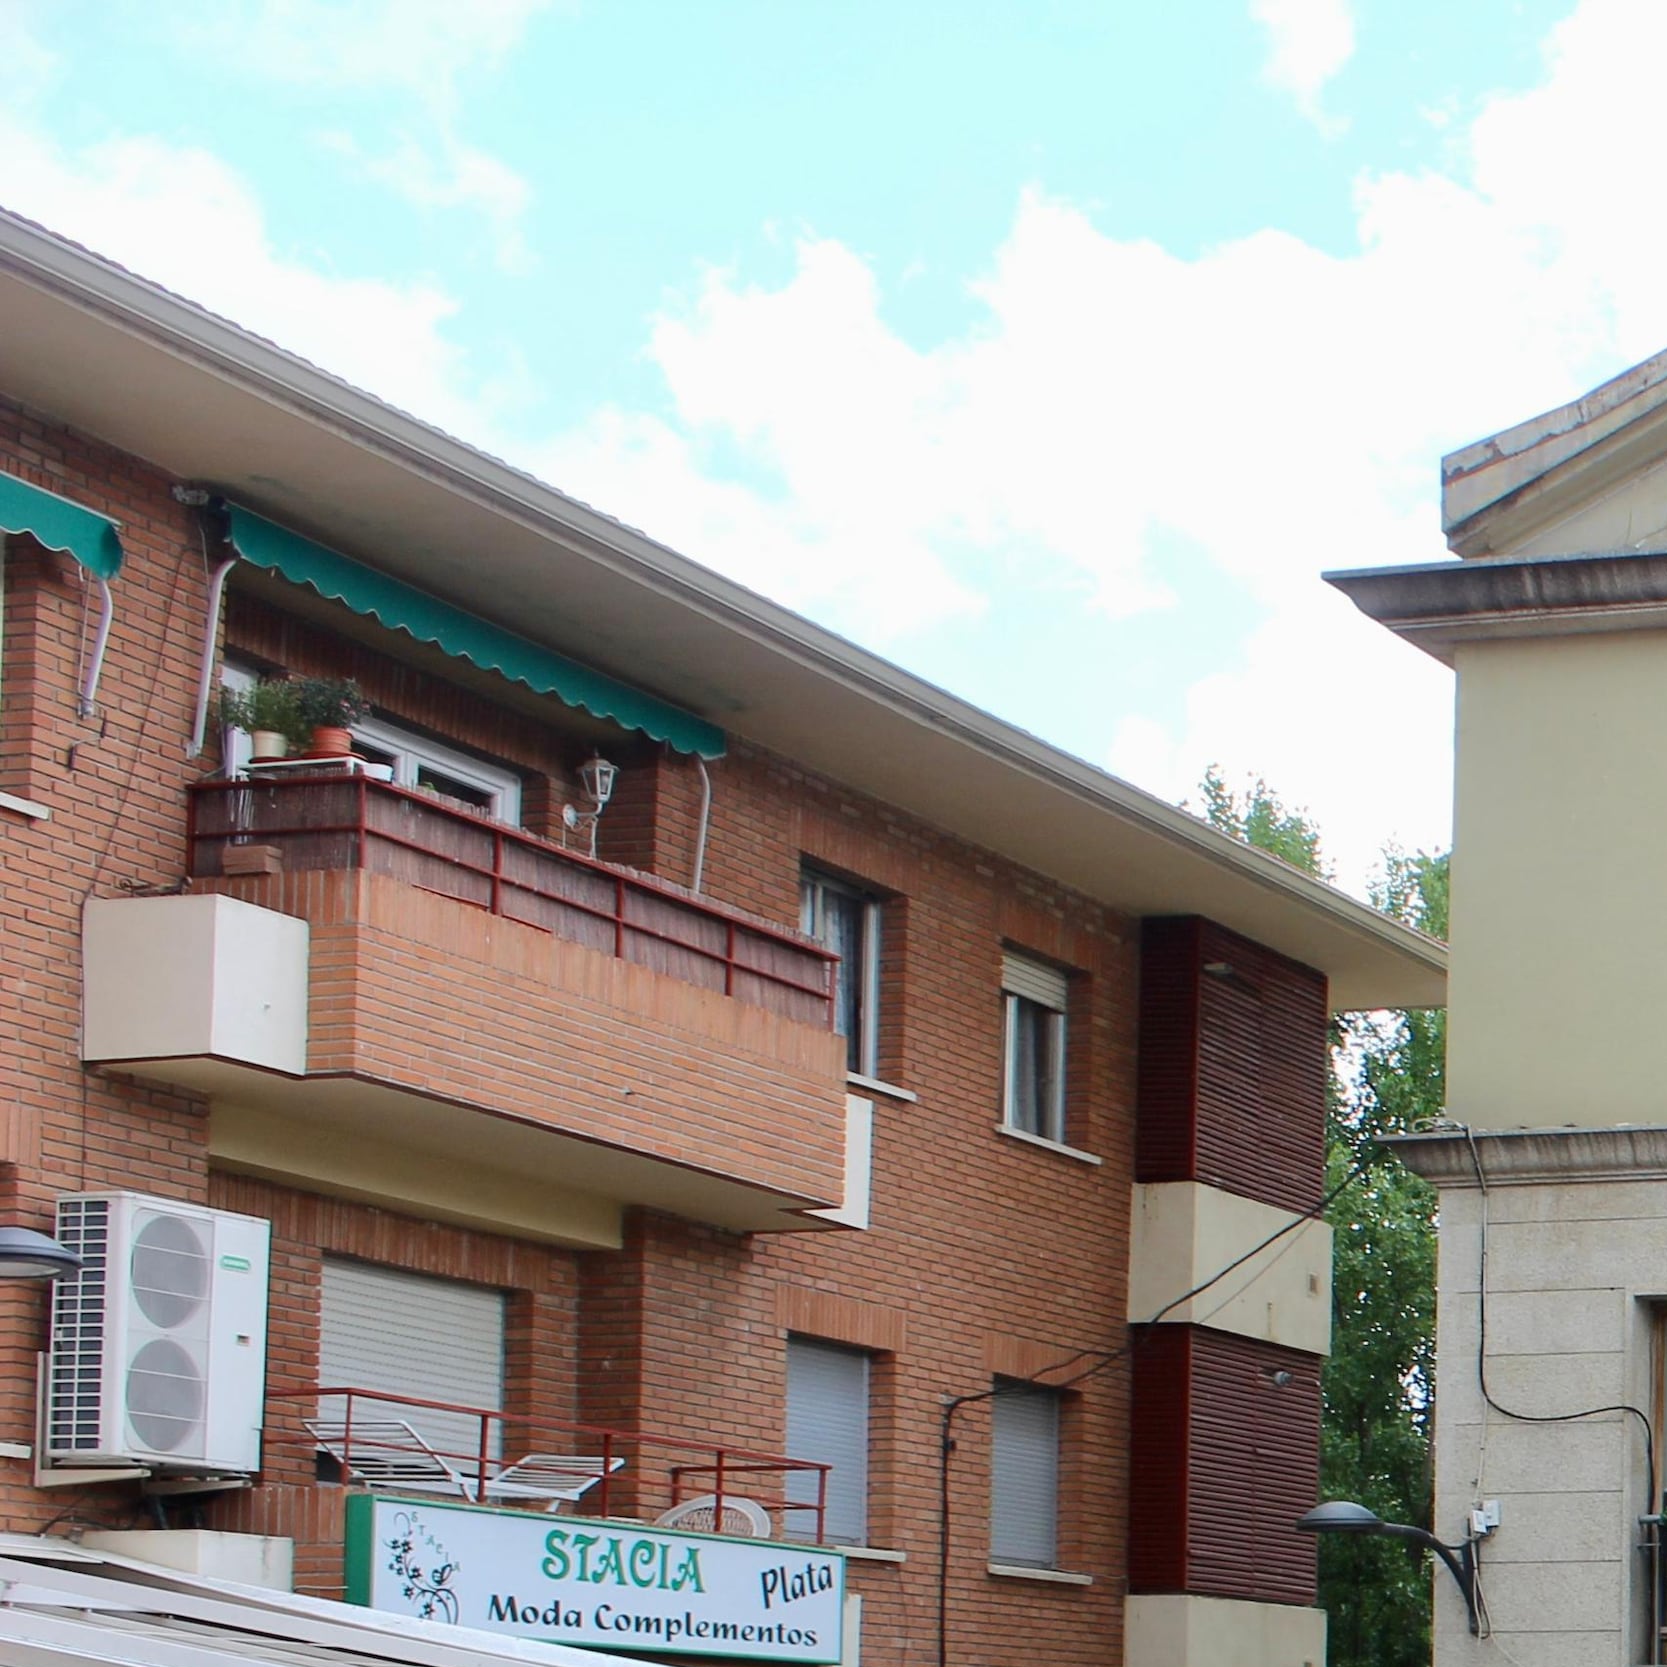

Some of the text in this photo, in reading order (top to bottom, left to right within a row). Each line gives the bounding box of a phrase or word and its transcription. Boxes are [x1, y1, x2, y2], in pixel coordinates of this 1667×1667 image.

[541, 1528, 707, 1594] STACIA
[760, 1562, 834, 1609] Plata
[487, 1593, 818, 1648] Moda Complementos
